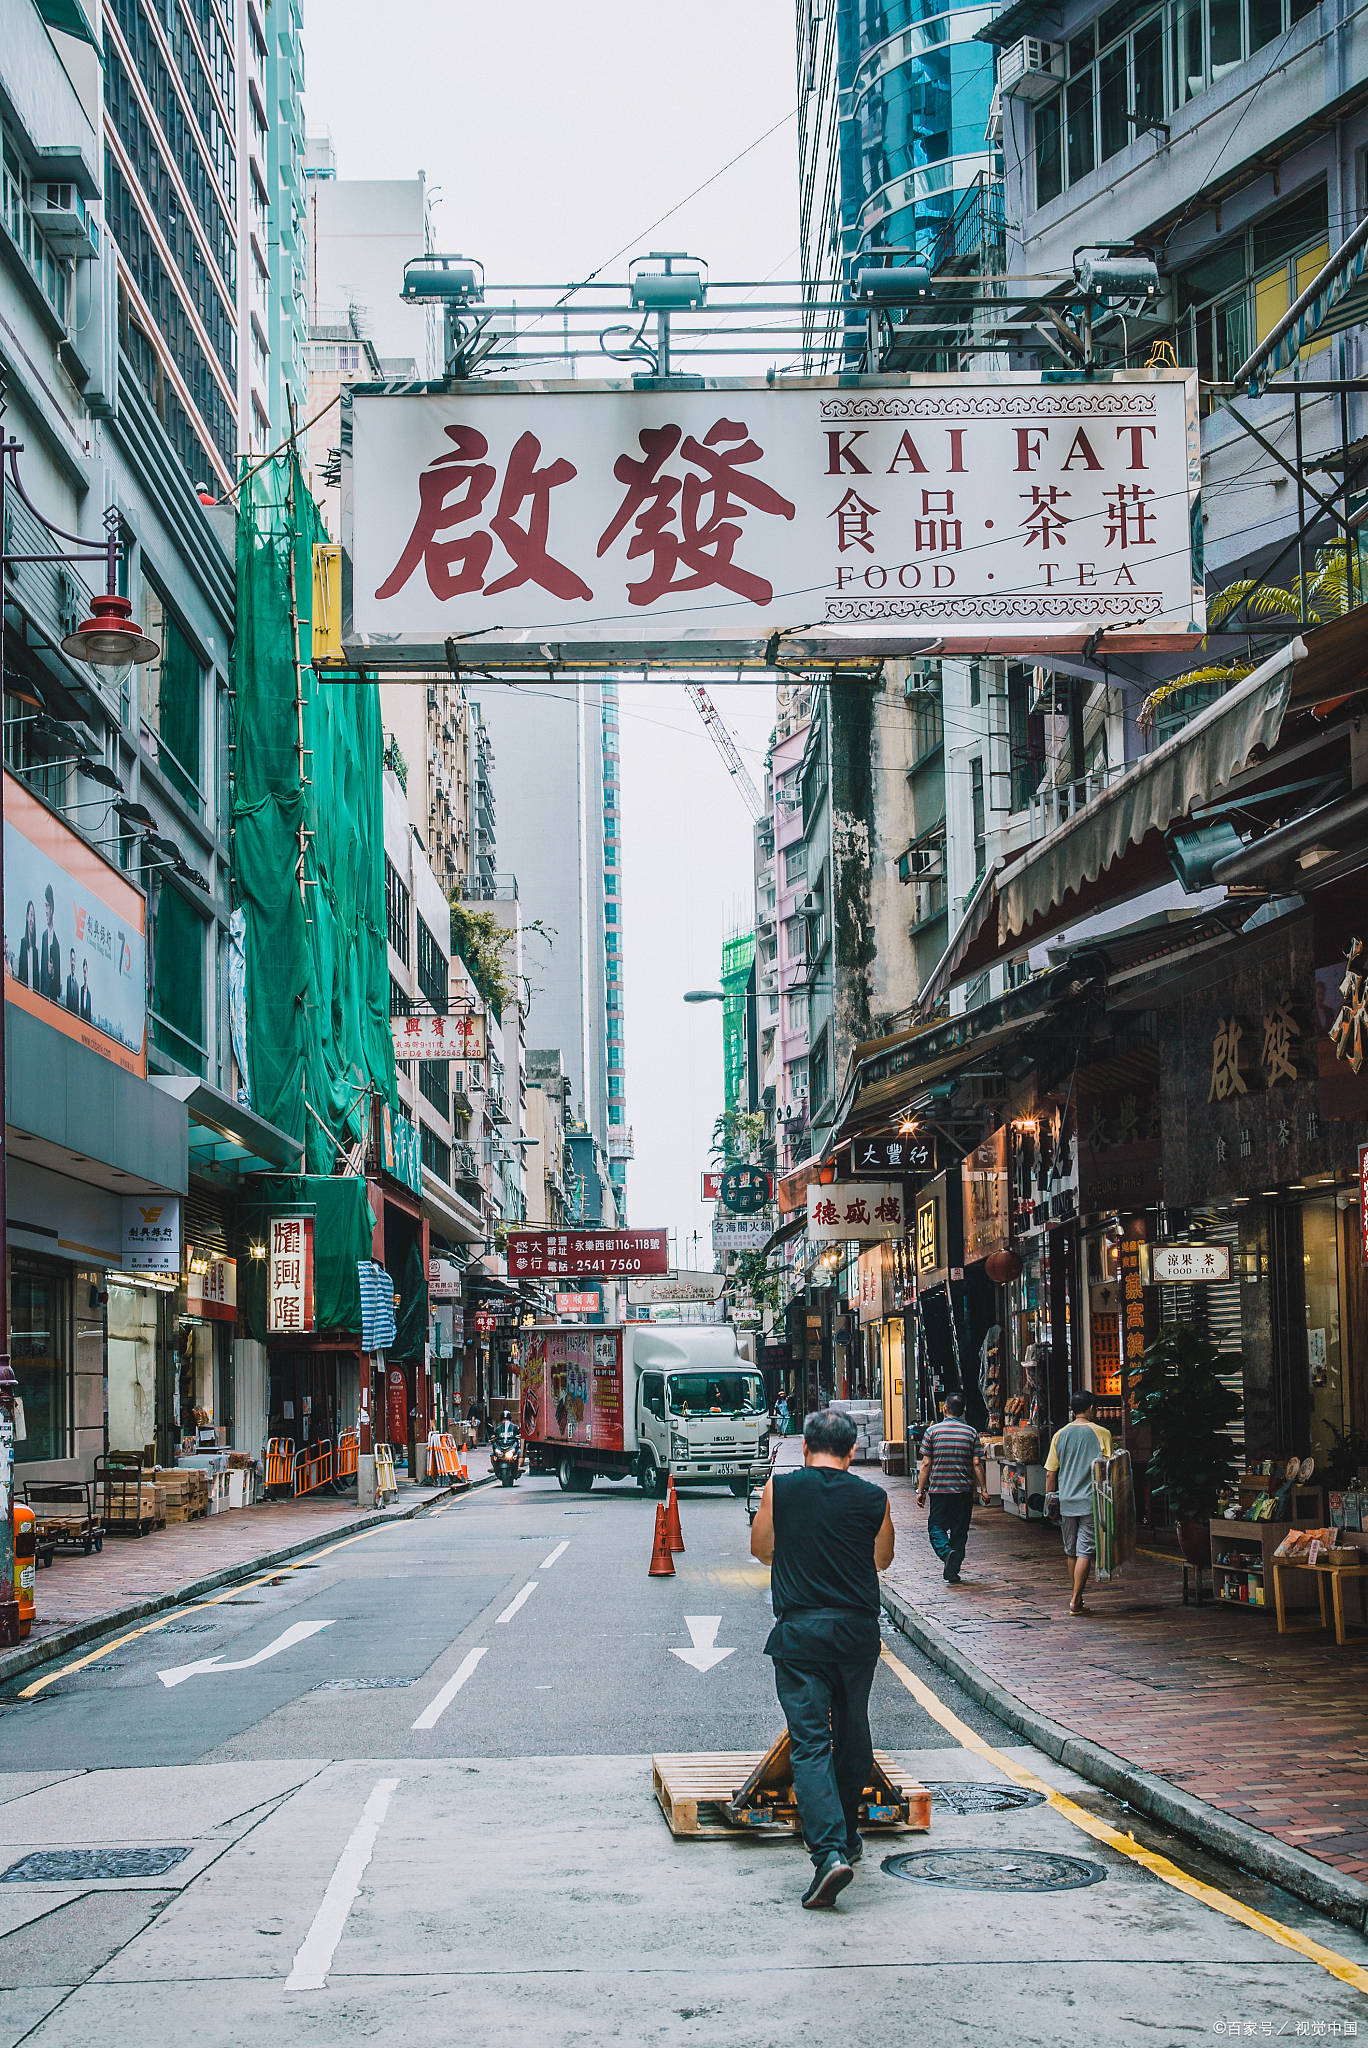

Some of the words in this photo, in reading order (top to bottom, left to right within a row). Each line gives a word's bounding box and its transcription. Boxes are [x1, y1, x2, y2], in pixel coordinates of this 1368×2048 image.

[823, 427, 969, 474] KAI
[1012, 425, 1158, 472] FAT
[375, 417, 796, 607] 啟發
[835, 564, 956, 591] FOOD
[1039, 562, 1136, 587] TEA
[390, 1017, 475, 1038] 興賓館
[1207, 996, 1300, 1104] 啟發
[860, 1142, 928, 1165] 大豐行
[577, 1260, 605, 1271] 2541
[610, 1258, 640, 1270] 7560
